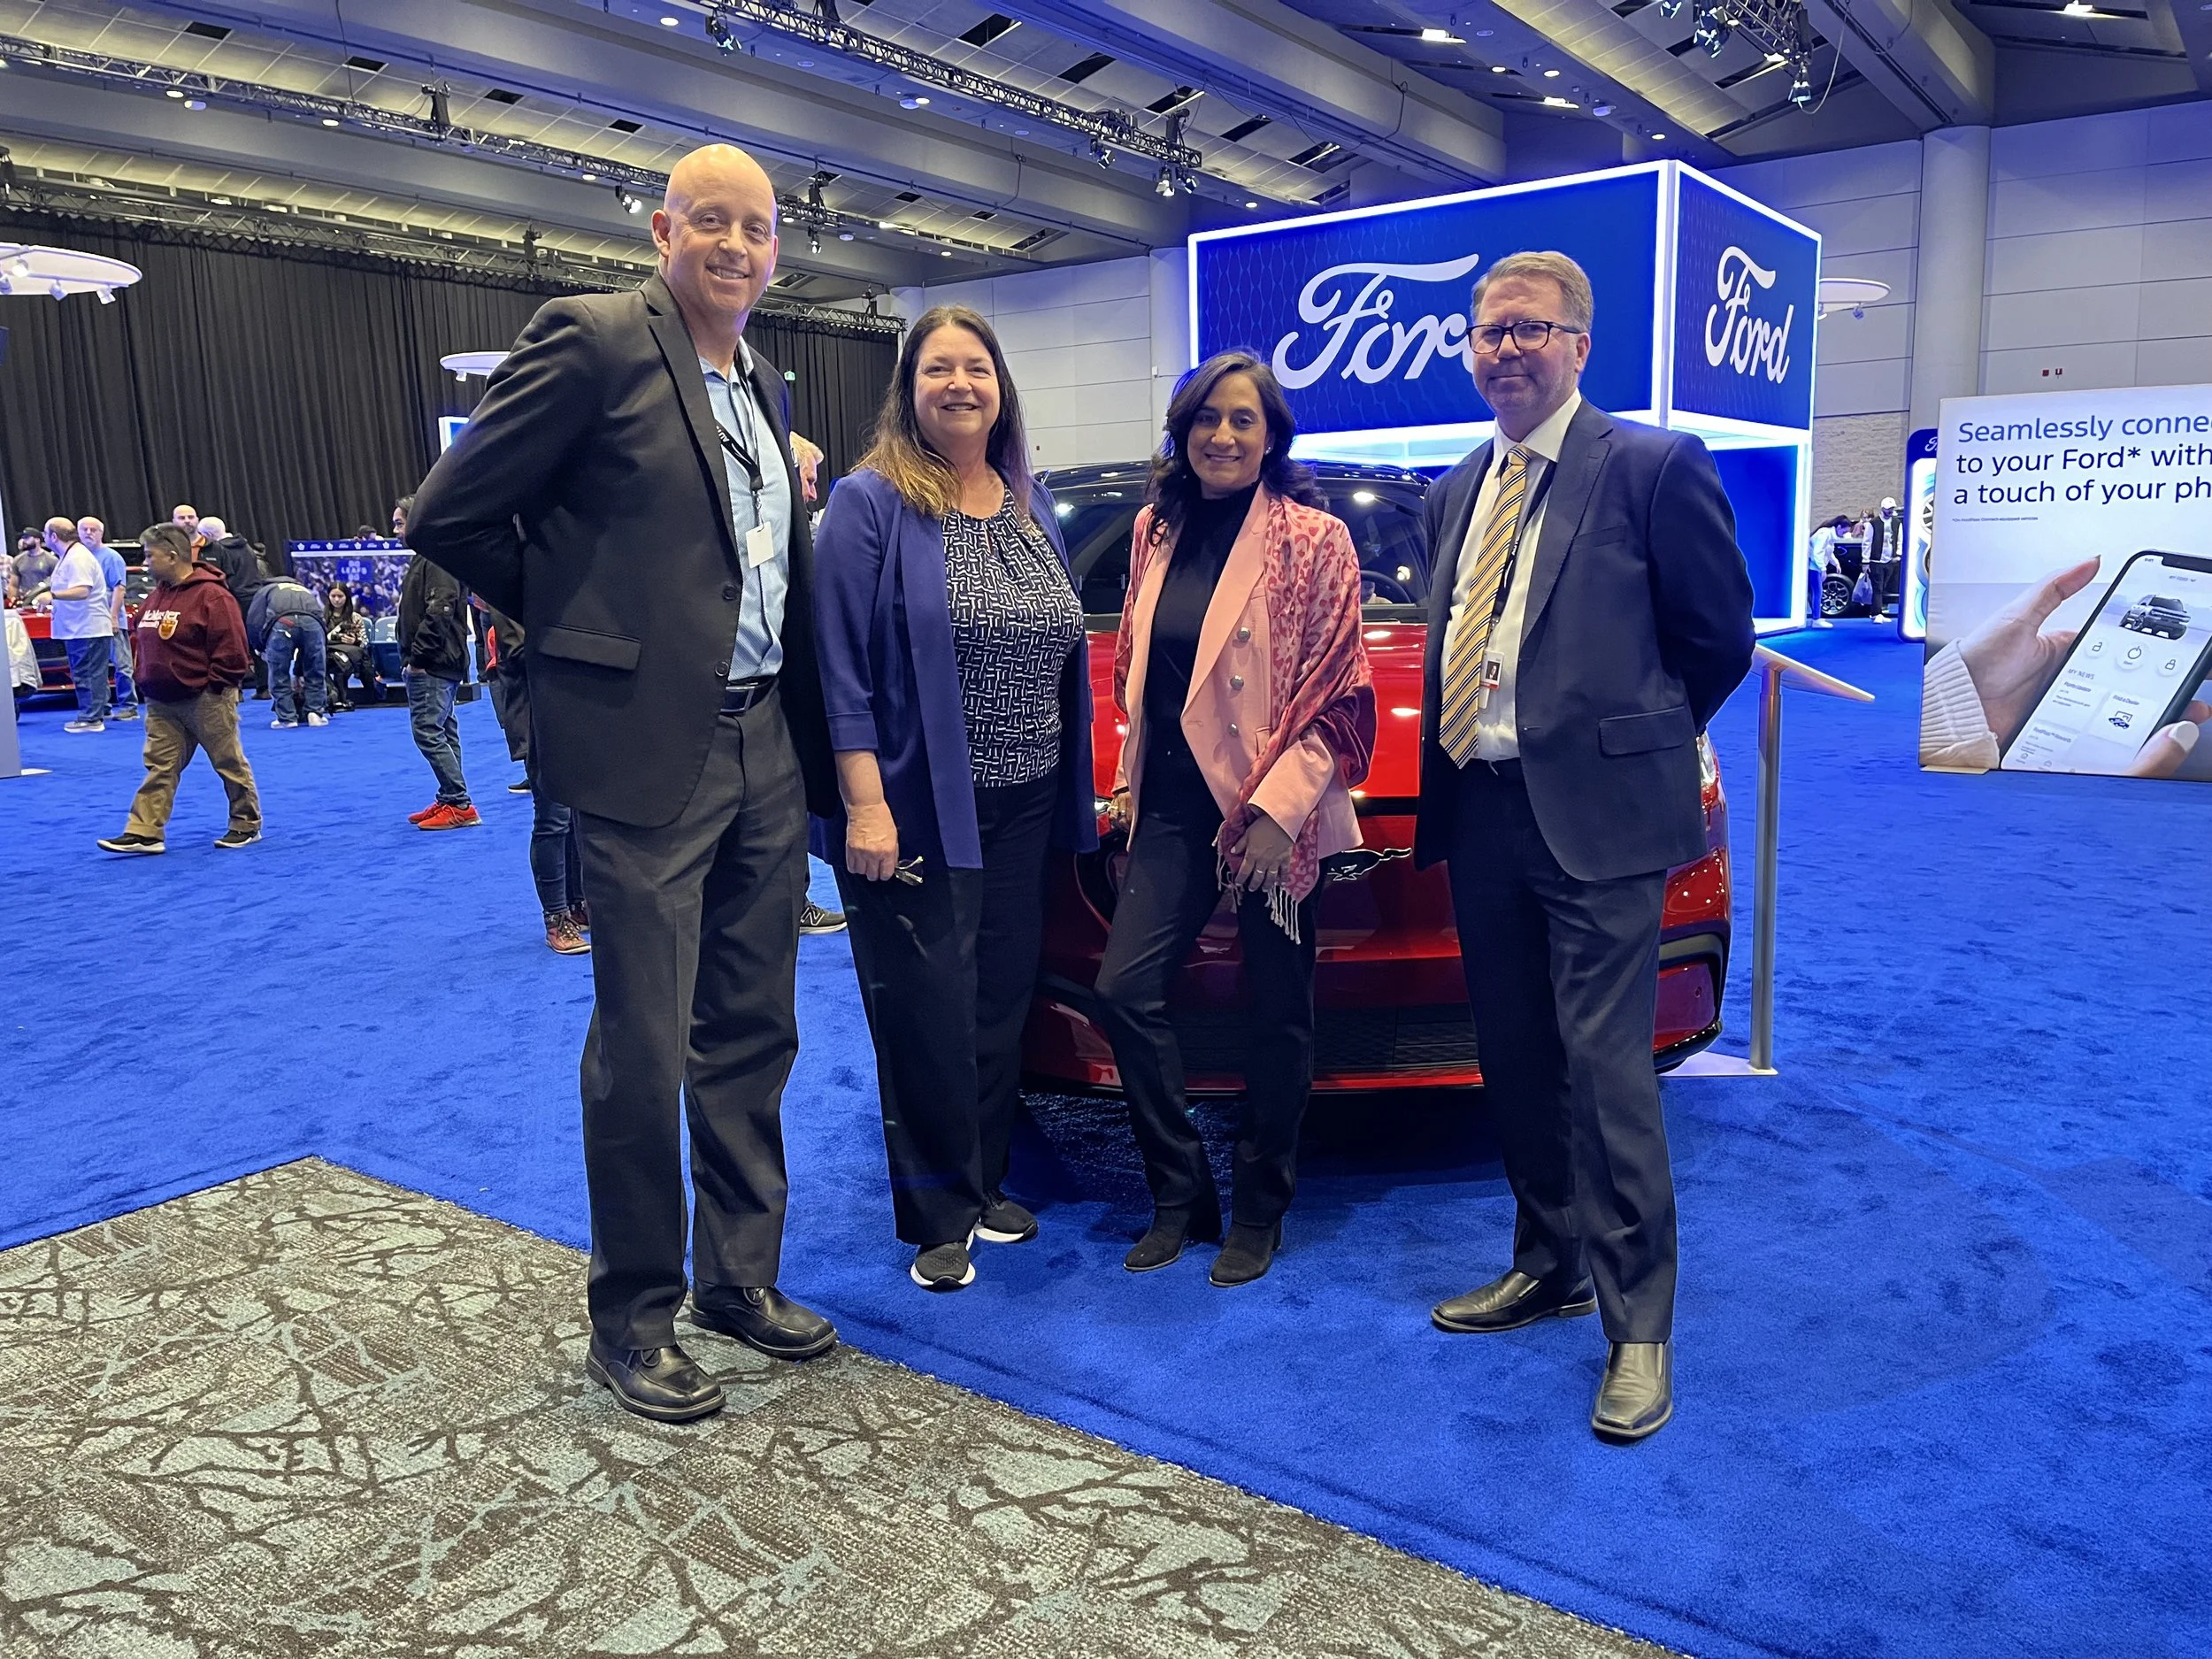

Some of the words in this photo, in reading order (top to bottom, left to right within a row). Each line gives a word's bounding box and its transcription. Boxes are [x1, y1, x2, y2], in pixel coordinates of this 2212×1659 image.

[1271, 253, 1479, 390] For
[1705, 246, 1794, 384] Ford
[1958, 415, 2114, 442] Seamlessly
[2122, 415, 2212, 435] conne
[1955, 454, 1983, 473] to
[1992, 454, 2055, 477] your
[2151, 442, 2212, 467] with
[1954, 488, 1968, 504] a
[1978, 480, 2055, 503] touch
[2065, 479, 2095, 502] of
[2101, 482, 2167, 505] your
[2175, 476, 2212, 503] ph
